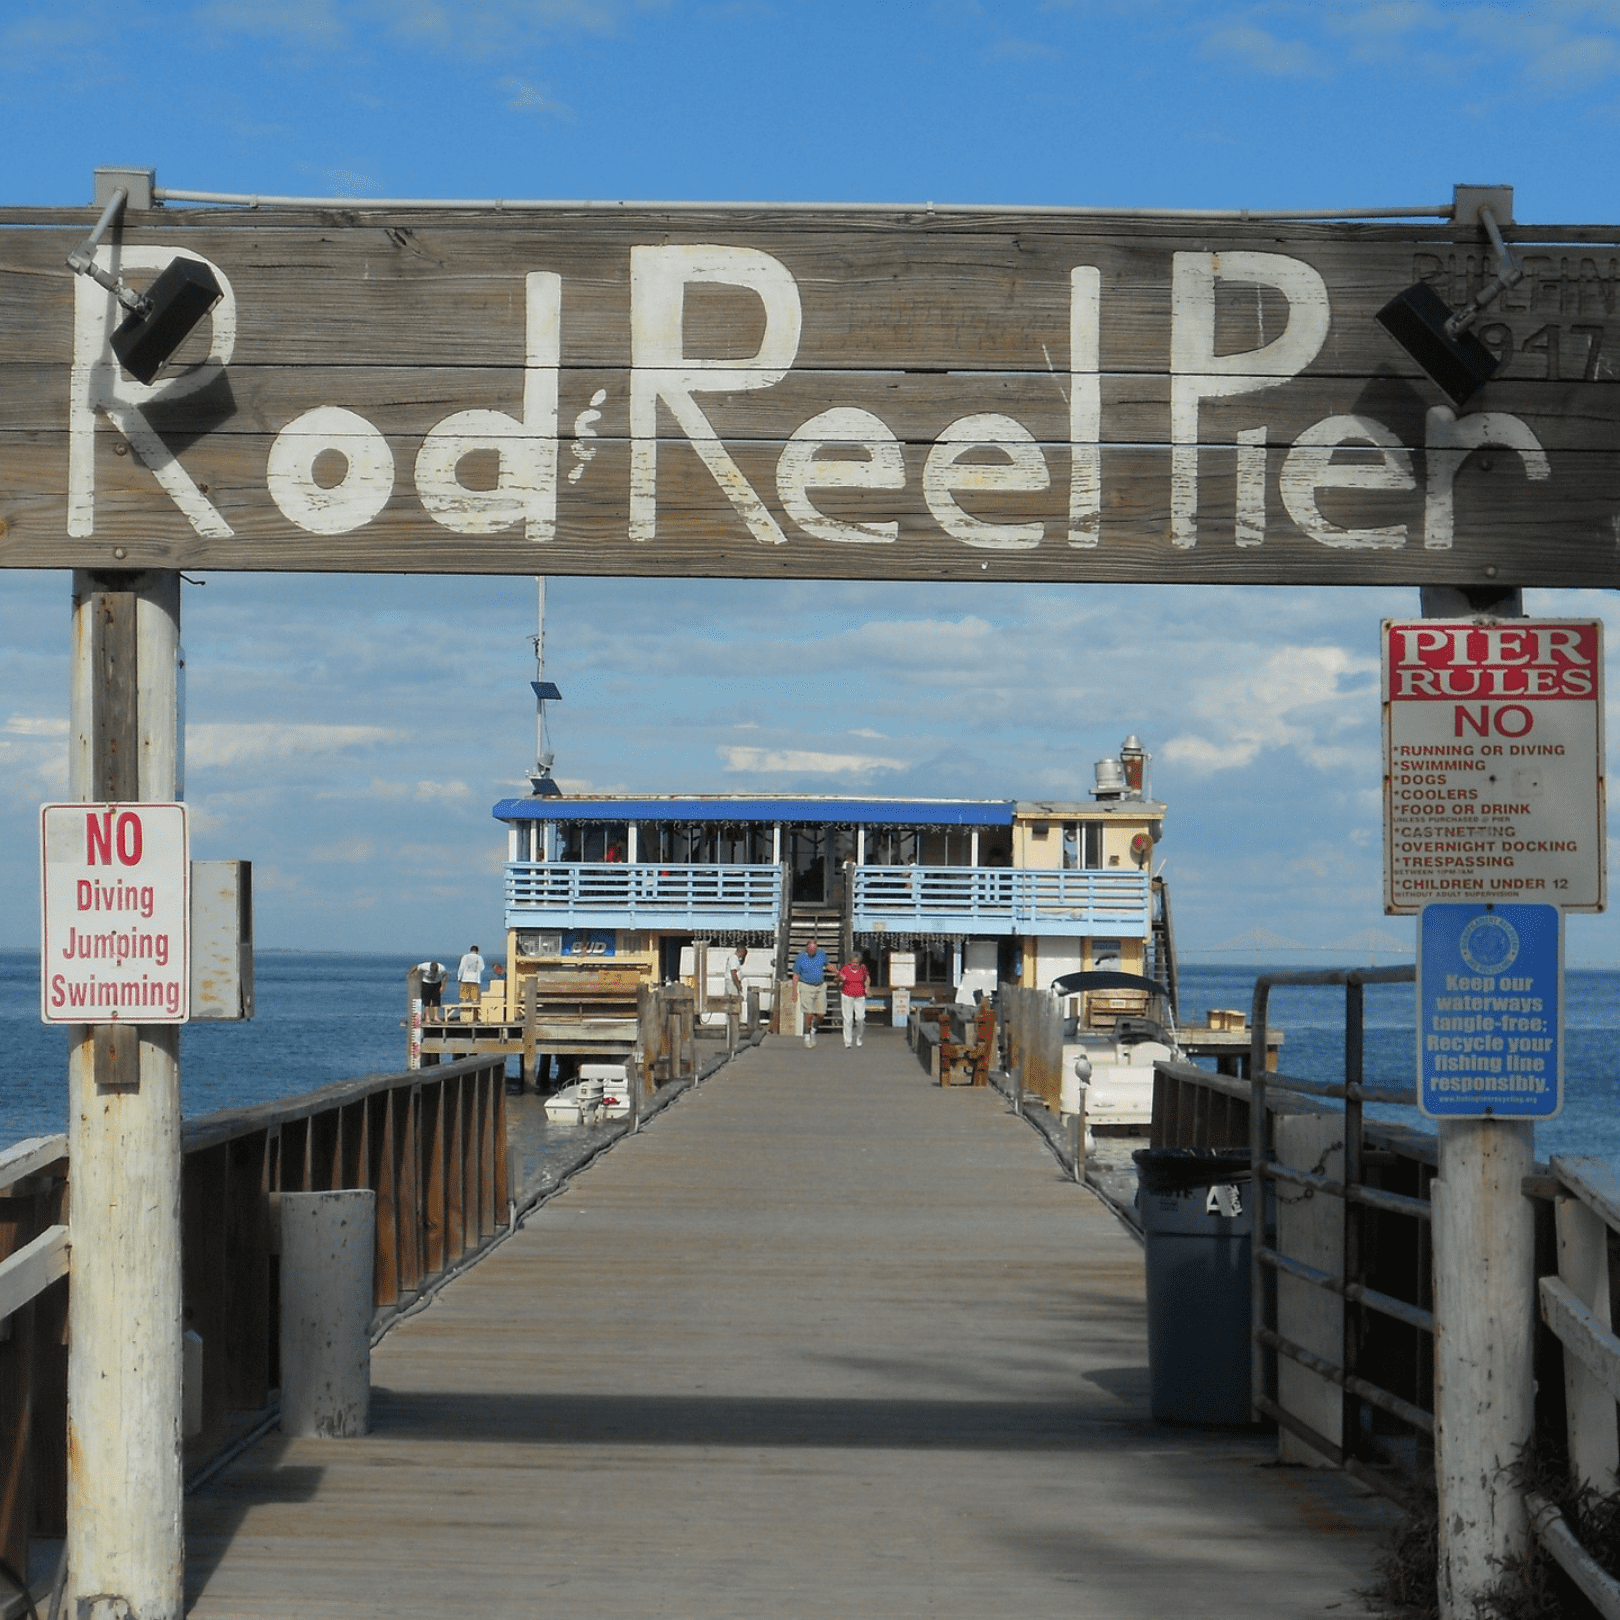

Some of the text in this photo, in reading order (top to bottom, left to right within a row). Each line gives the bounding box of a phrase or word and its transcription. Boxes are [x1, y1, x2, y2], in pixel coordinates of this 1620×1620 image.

[1478, 323, 1605, 381] 947
[67, 245, 562, 543] Rod
[628, 243, 1101, 549] Reel
[1170, 251, 1551, 550] Pier
[1396, 629, 1591, 666] PIER
[1396, 669, 1593, 696] RULES
[1454, 704, 1534, 738] NO
[1401, 745, 1566, 756] RUNNING OR DIVING
[1401, 760, 1486, 772] SWIMMING
[1401, 774, 1447, 785] DOGS
[1401, 789, 1478, 800] COOLERS
[1401, 804, 1531, 815] FOOD OR DRINK
[86, 811, 144, 867] NO
[1401, 826, 1516, 838] CASTNETTING
[1402, 841, 1577, 852] OVERNIGHT DOCKING
[1402, 856, 1515, 868] TRESPASSING
[1402, 878, 1569, 890] CHILDREN UNDER 12
[77, 879, 154, 919] Diving
[62, 926, 169, 967] Jumping
[1446, 974, 1534, 992] Keep our
[51, 974, 180, 1014] Swimming
[1436, 996, 1543, 1013] waterways
[1426, 1034, 1553, 1053] Recycle your
[1435, 1054, 1546, 1073] fishing line
[1430, 1075, 1550, 1094] responsibly.
